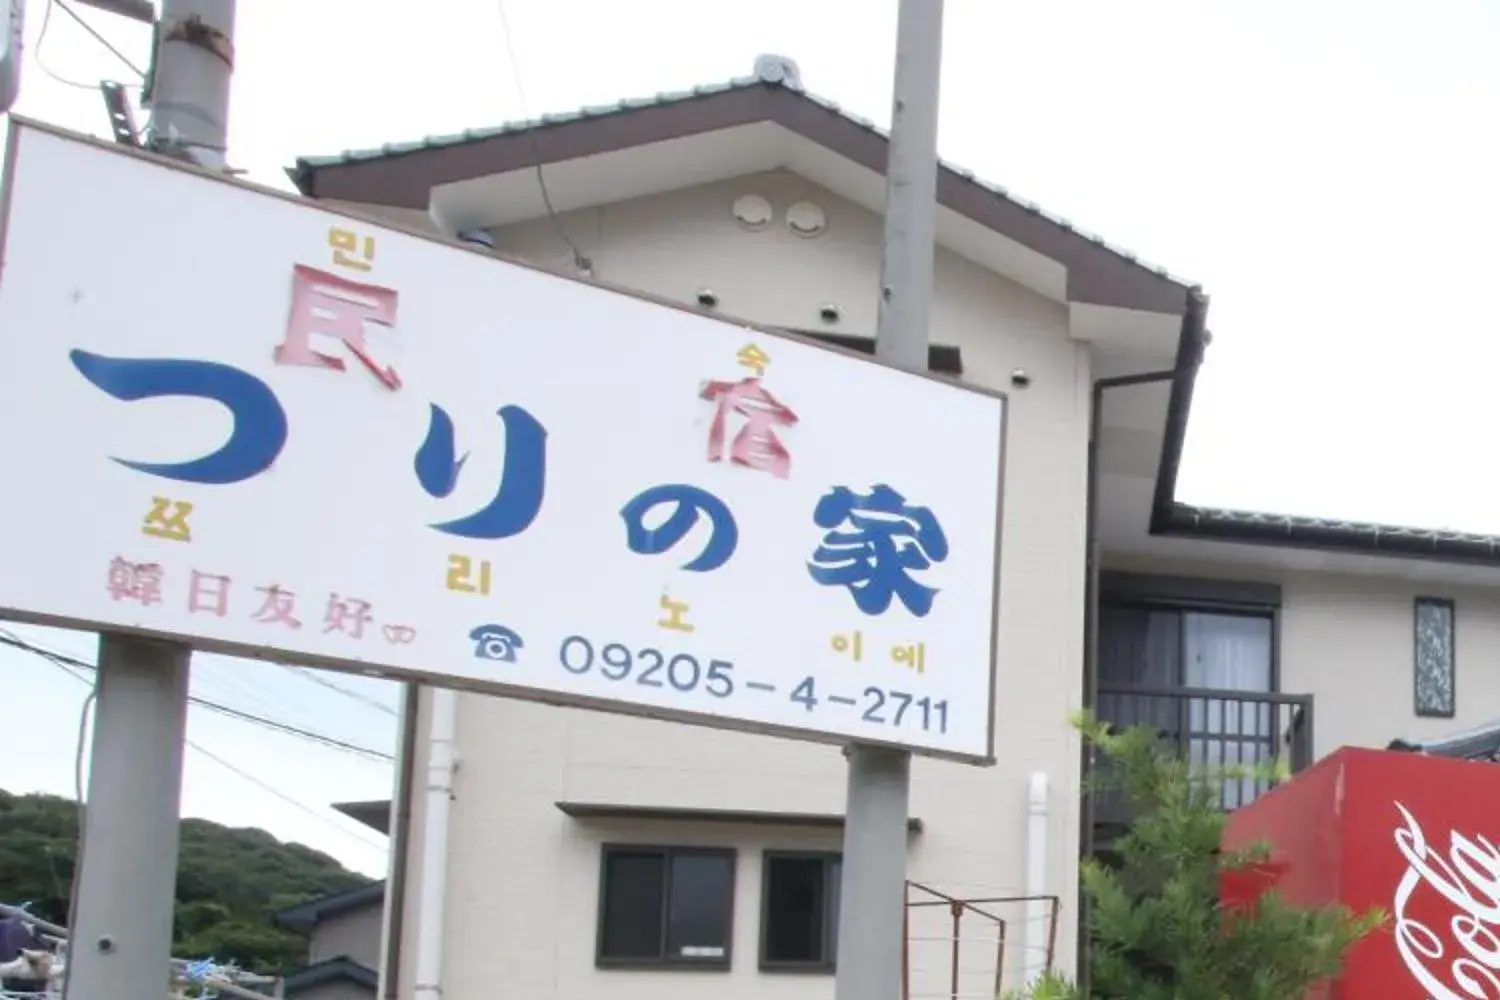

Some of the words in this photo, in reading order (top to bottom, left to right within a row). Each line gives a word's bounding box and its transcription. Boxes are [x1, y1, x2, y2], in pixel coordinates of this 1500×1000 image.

[328, 226, 375, 272] 민
[274, 263, 402, 391] 民
[70, 348, 949, 617] つりの家
[445, 553, 492, 597] 리
[657, 594, 694, 634] 노
[559, 634, 949, 735] 09205-4-2711
